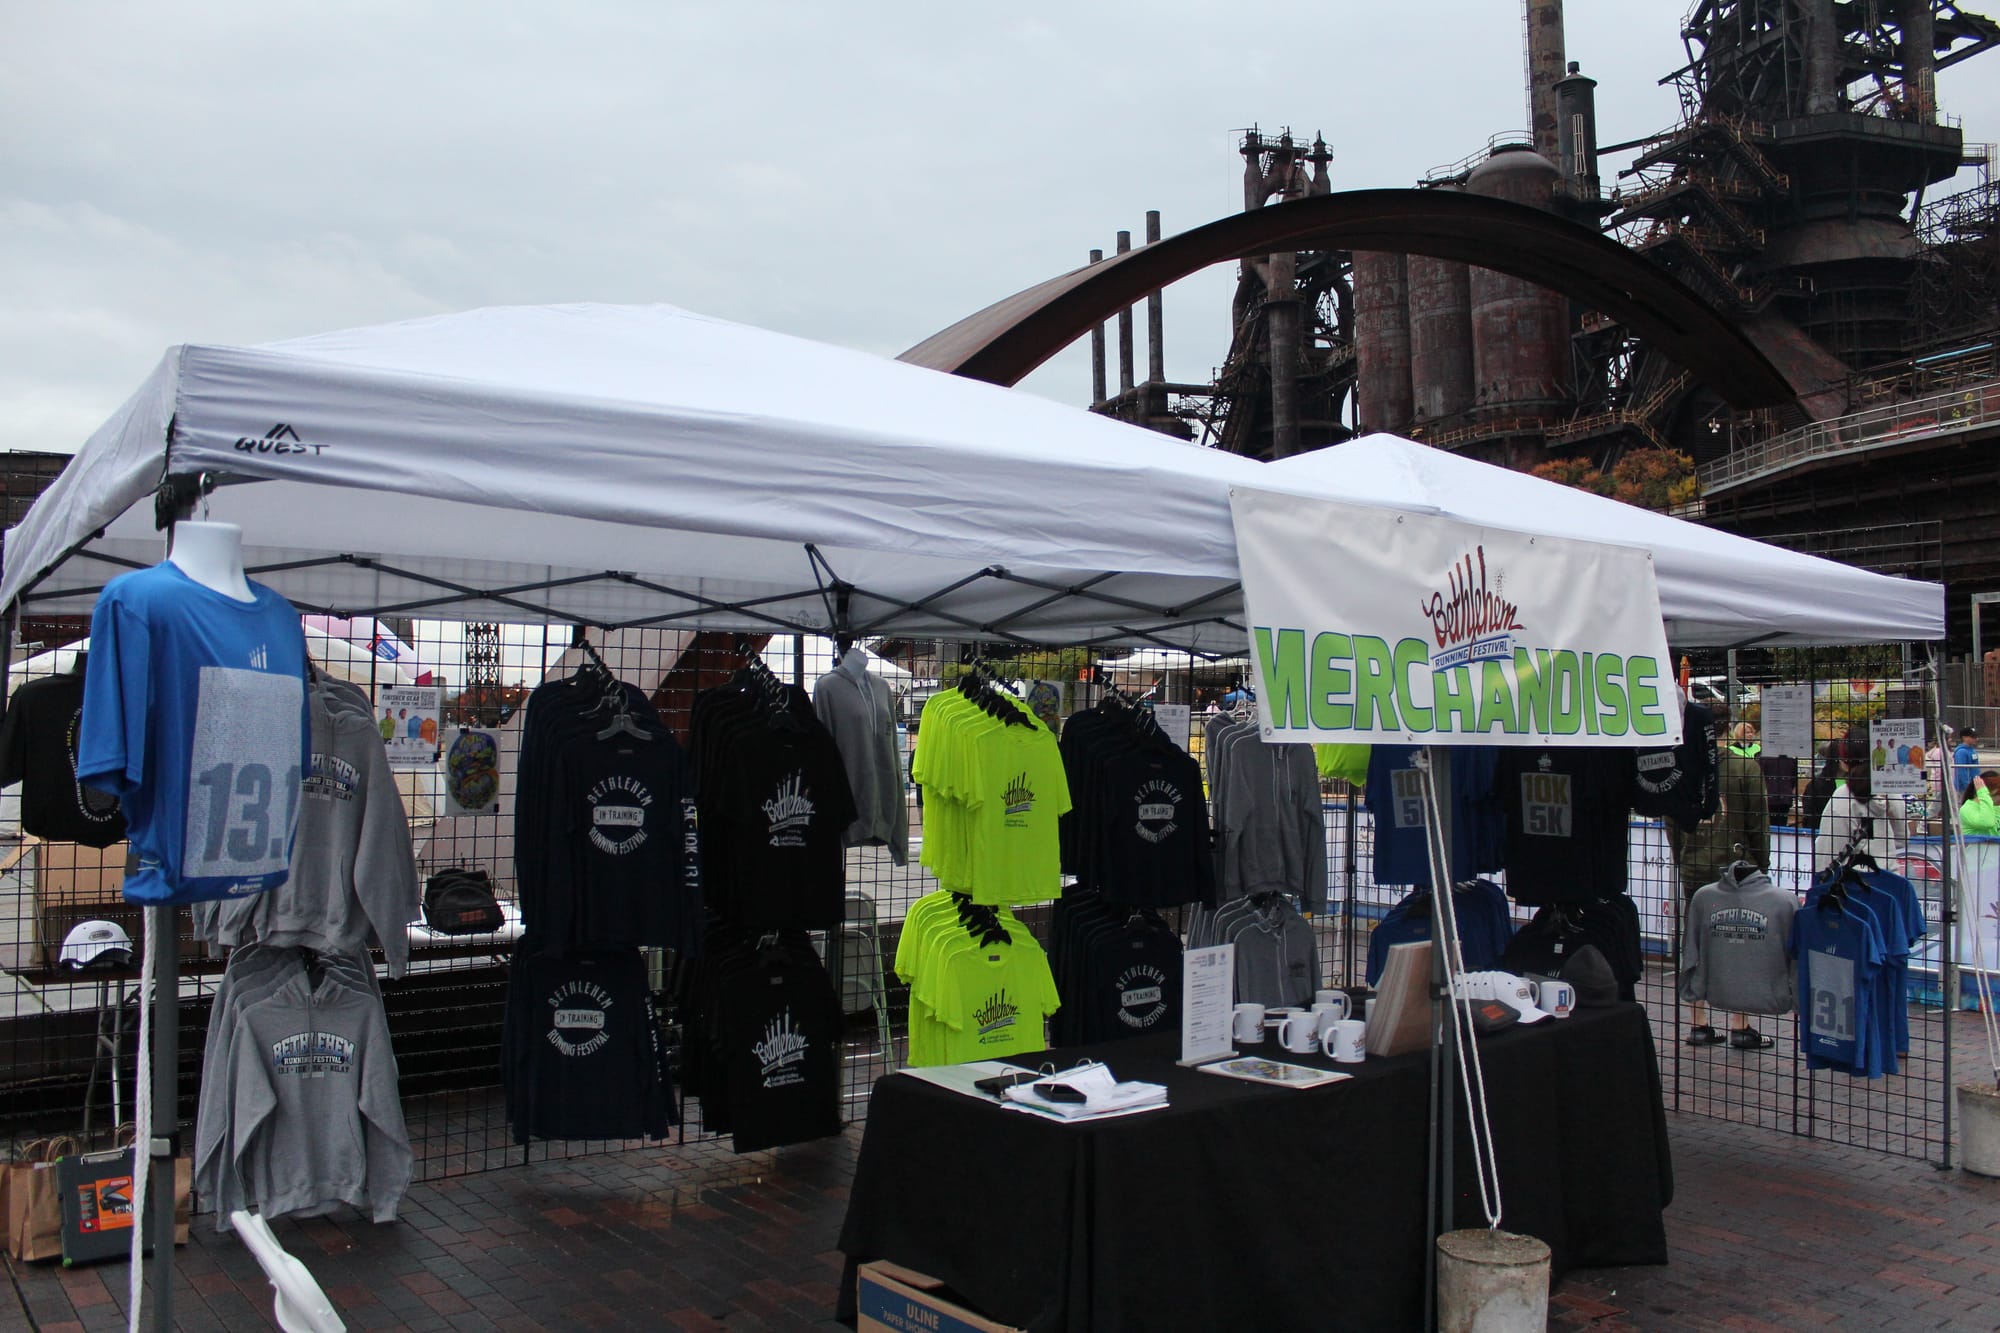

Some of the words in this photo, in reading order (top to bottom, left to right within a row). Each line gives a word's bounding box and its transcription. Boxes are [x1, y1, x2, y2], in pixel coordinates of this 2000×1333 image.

[235, 437, 330, 456] QUEST
[1421, 545, 1527, 662] Bethlehem
[1435, 648, 1469, 668] RUNNING
[1473, 640, 1509, 657] FESTIVAL
[1254, 626, 1667, 737] MERCHANDISE
[587, 776, 653, 807] BETHLEHEM
[1134, 779, 1183, 804] BETHLEHEM
[1391, 770, 1423, 798] 10
[1523, 774, 1569, 806] 10K
[761, 775, 816, 823] Bethlehem
[608, 809, 639, 821] TRAINING
[1529, 805, 1564, 835] 5K
[588, 826, 619, 855] RUNNING
[619, 828, 648, 855] FESTIVAL
[684, 832, 698, 854] 10K
[1710, 907, 1769, 934] BETHLEHEM
[1115, 964, 1166, 991] BETHLEHEM
[548, 980, 614, 1009] BETHLEHEM
[972, 987, 1021, 1027] Bethlehem
[568, 1012, 599, 1024] TRAINING
[1143, 1000, 1168, 1027] FESTIVAL
[272, 1031, 355, 1067] BETHLEHEM
[546, 1028, 576, 1057] RUNNING
[576, 1030, 610, 1057] FESTIVAL
[751, 1012, 810, 1065] Bethlehem
[312, 1055, 343, 1064] FESTIVAL
[906, 1303, 940, 1331] ULINE
